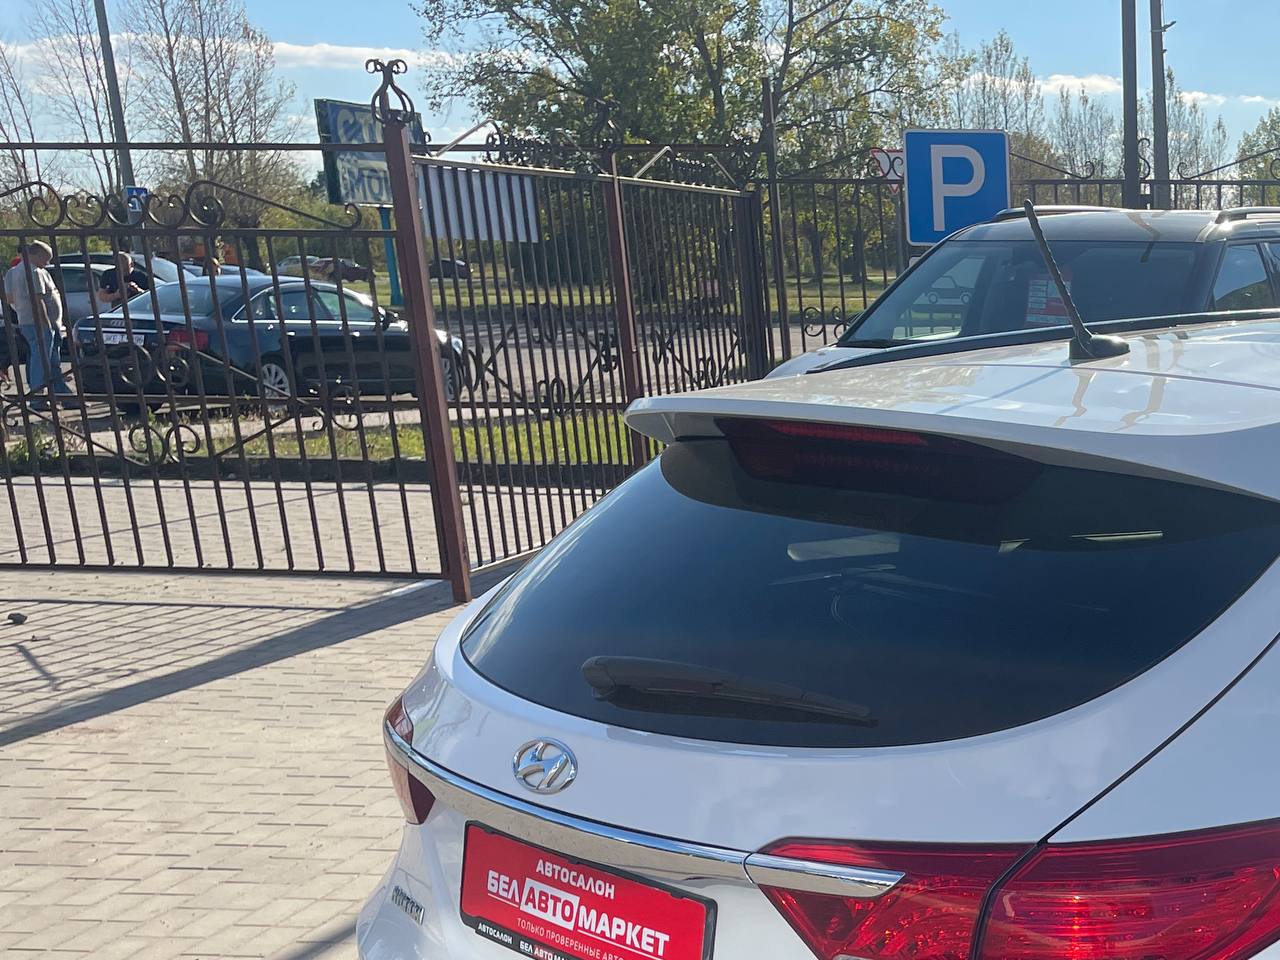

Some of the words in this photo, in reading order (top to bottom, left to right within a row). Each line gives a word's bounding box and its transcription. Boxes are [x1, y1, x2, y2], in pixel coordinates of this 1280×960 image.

[930, 144, 985, 232] P
[536, 859, 615, 899] АВТОСАЛОН
[477, 922, 513, 945] АВТОСАЛОН
[517, 918, 545, 936] ТОЛЬКО
[546, 930, 601, 960] ПРОВЕРЕННЫЕ
